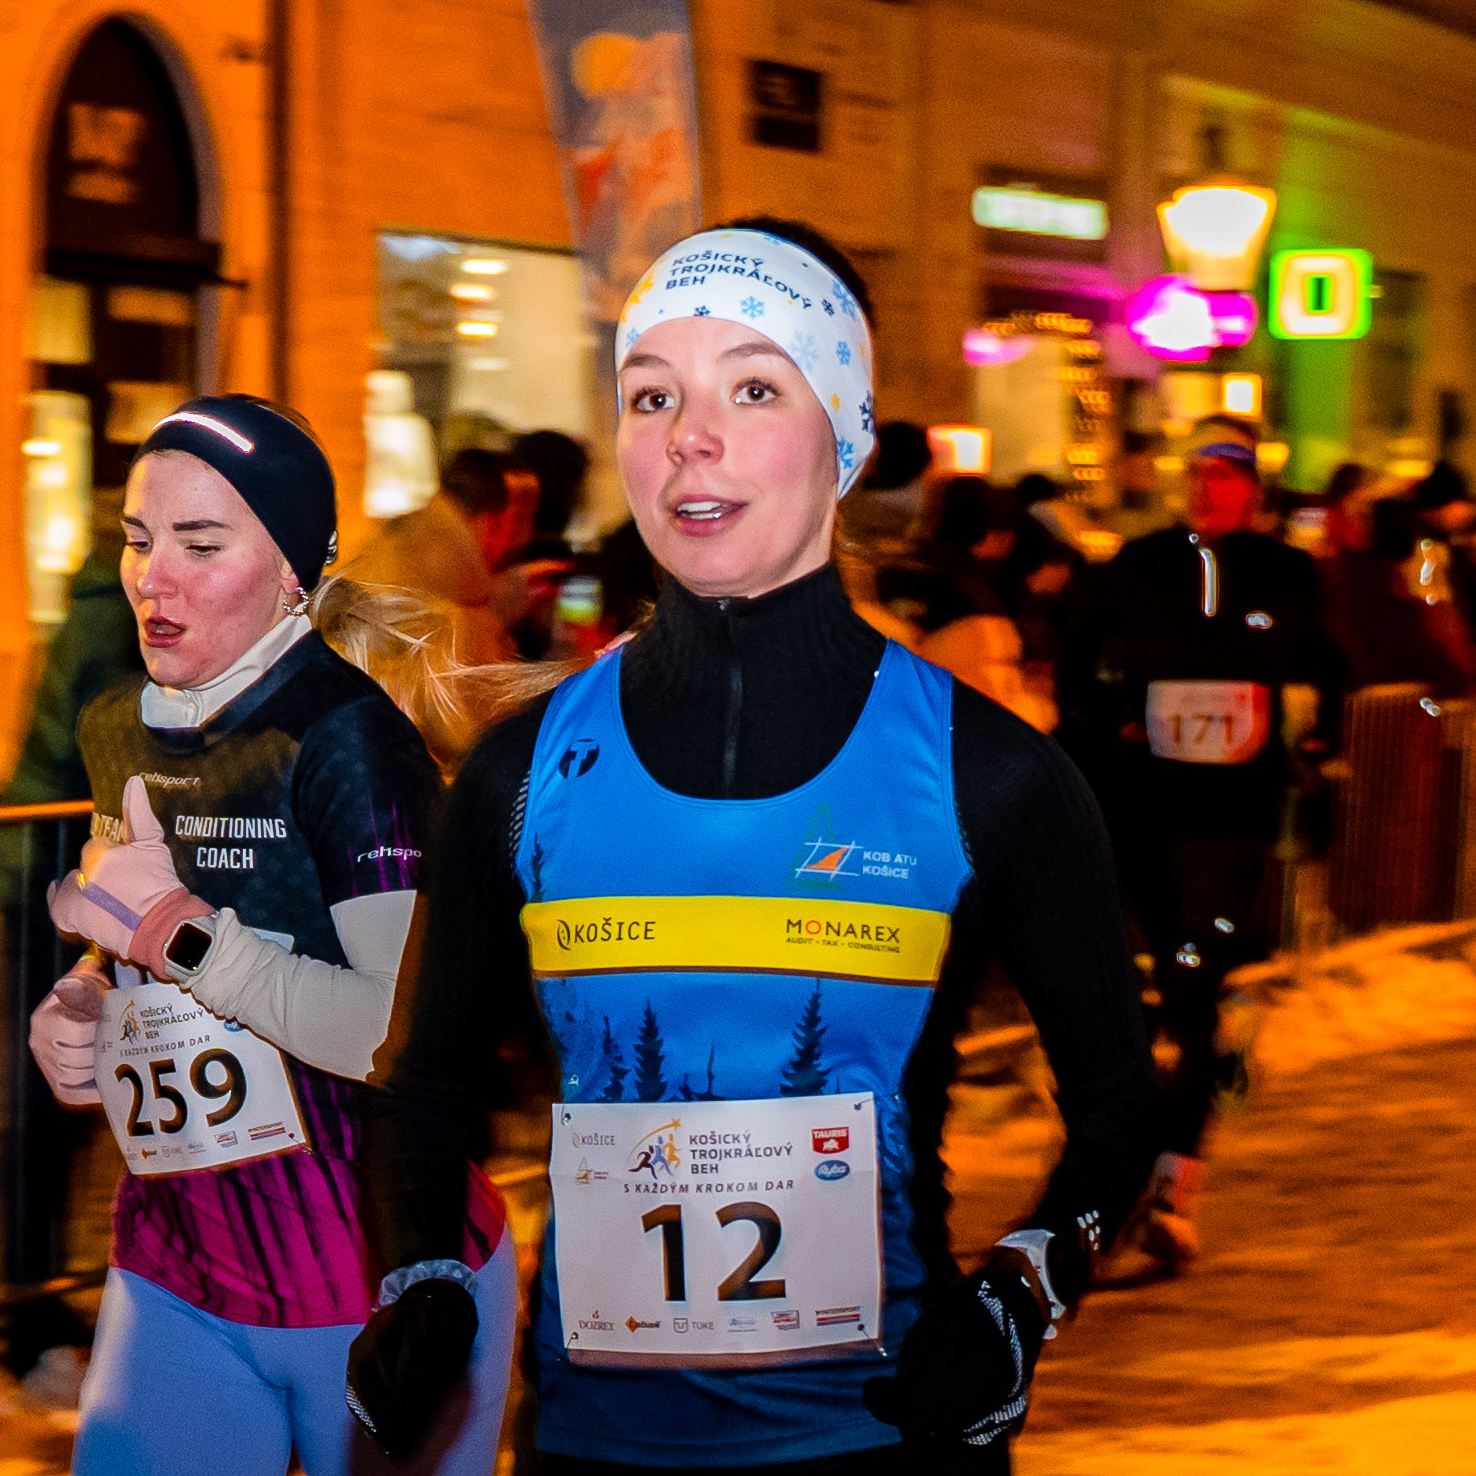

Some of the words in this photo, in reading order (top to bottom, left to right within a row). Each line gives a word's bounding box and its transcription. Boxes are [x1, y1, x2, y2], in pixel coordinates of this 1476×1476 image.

[672, 250, 764, 267] KOŠICKÝ
[665, 275, 706, 290] BEH
[1171, 714, 1234, 745] 171
[175, 815, 287, 838] CONDITIONING
[196, 847, 254, 869] COACH
[863, 851, 890, 862] KOB
[894, 854, 917, 865] ATU
[863, 865, 909, 879] KOŠICE
[574, 917, 656, 943] KOŠICE
[786, 919, 900, 943] MONAREX
[189, 1035, 211, 1046] DAR
[114, 1048, 247, 1137] 259
[689, 1130, 752, 1145] KOŠICKÝ
[690, 1142, 793, 1161] TROJKRÁĽOVÝ
[691, 1164, 719, 1174] BEH
[624, 1184, 630, 1193] S
[635, 1182, 689, 1194] KAŽDÝM
[695, 1182, 758, 1193] KROKOM
[765, 1180, 794, 1191] DAR
[641, 1202, 787, 1302] 12
